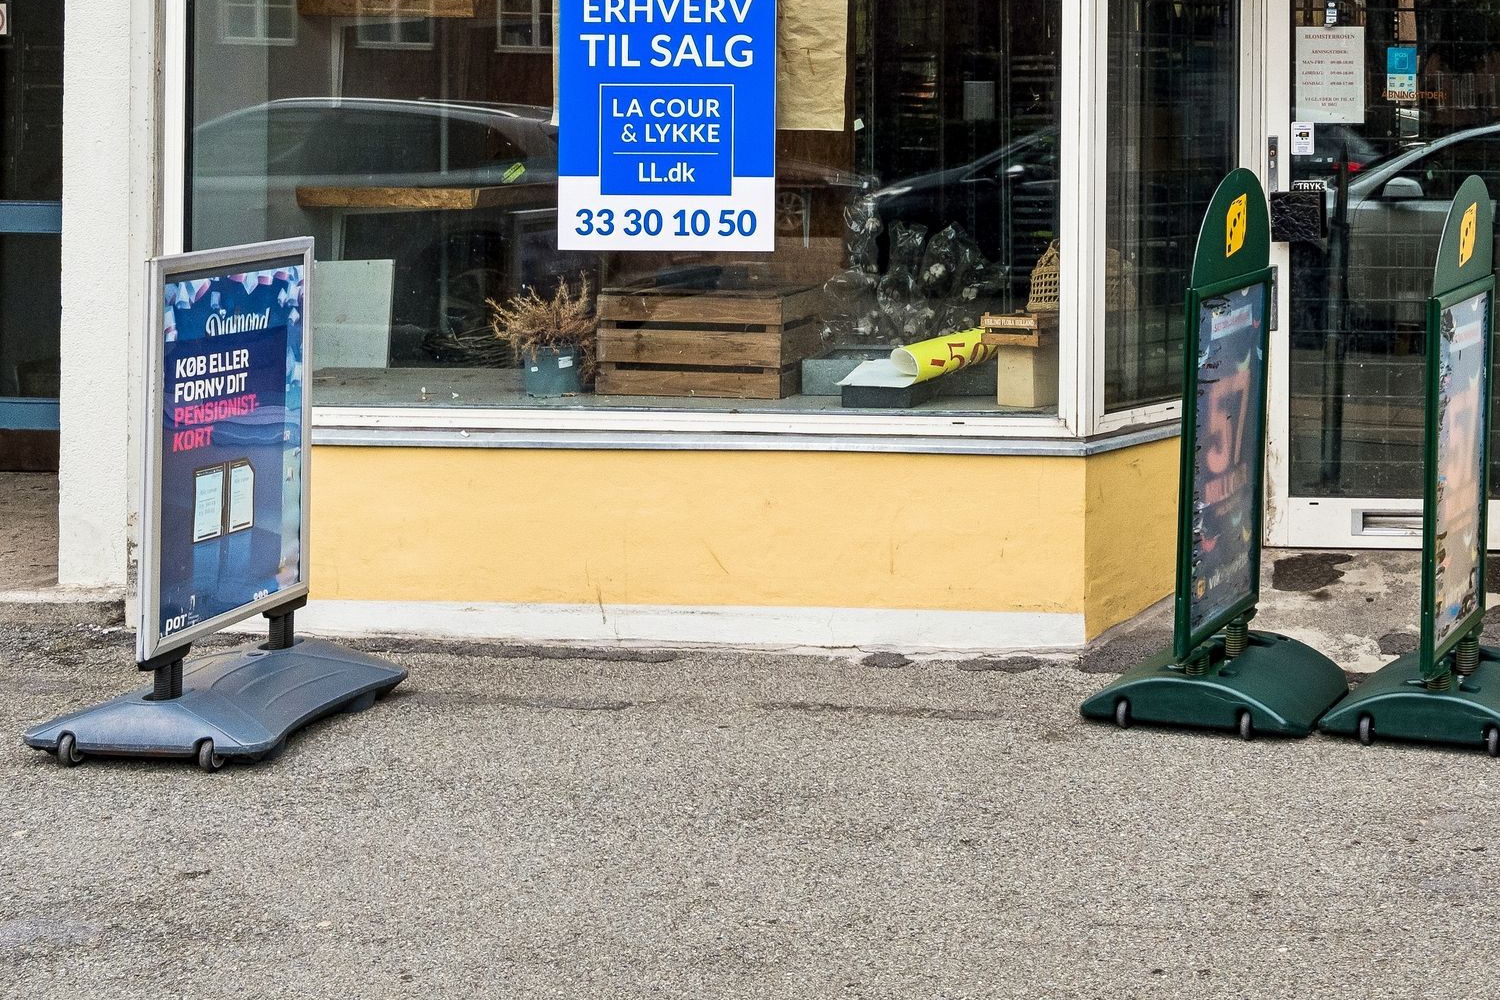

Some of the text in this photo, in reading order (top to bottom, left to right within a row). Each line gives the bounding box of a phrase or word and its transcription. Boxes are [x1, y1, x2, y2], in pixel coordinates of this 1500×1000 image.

[579, 33, 754, 68] TIL SALG
[612, 98, 721, 118] LA COUR
[620, 123, 721, 143] & LYKKE
[638, 161, 696, 183] LL.dk
[1299, 182, 1321, 190] TRYK
[575, 208, 757, 237] 33 30 10 50
[175, 348, 250, 379] KØB ELLER
[174, 372, 248, 404] FORNY DIT
[174, 393, 260, 428] PENSIONIST-
[172, 425, 214, 452] KORT
